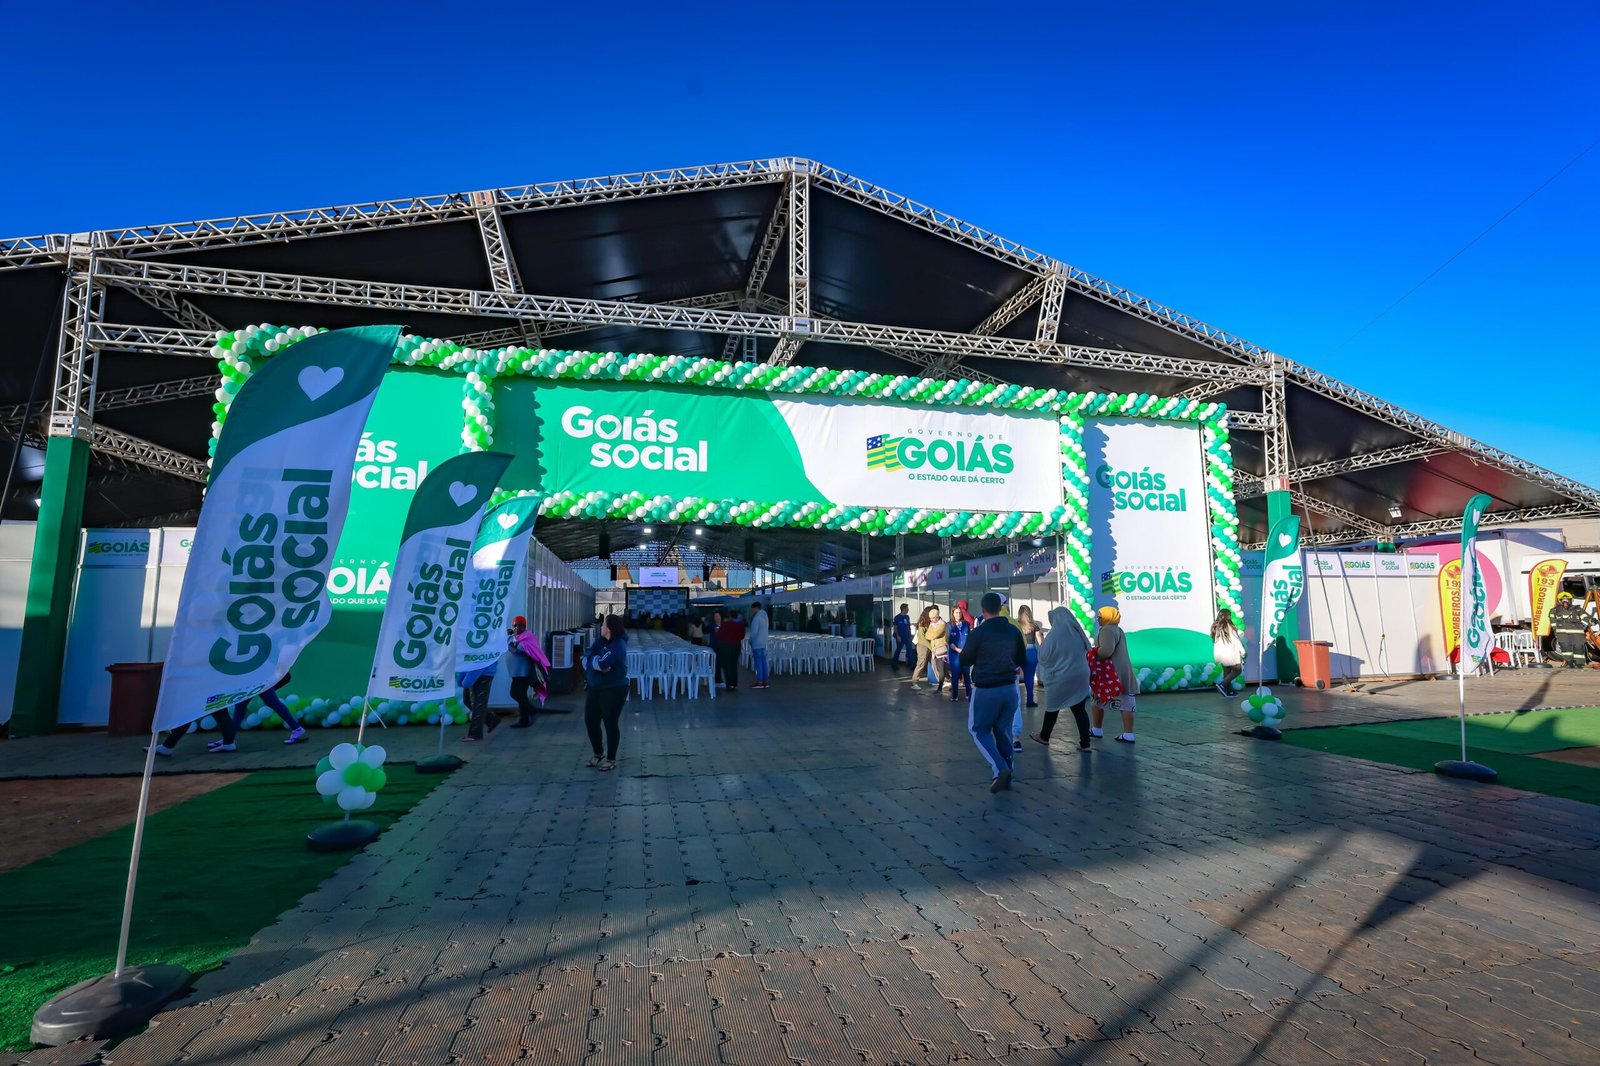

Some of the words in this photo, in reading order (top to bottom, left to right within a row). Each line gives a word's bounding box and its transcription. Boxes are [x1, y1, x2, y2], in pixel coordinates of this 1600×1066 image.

[561, 405, 679, 444] Goiás
[907, 428, 973, 438] GOVERNO
[589, 440, 708, 472] social
[896, 434, 1014, 474] GOIÁS
[917, 474, 948, 482] ESTADO
[949, 475, 966, 483] QUE
[968, 474, 979, 483] DÁ
[980, 476, 1005, 485] CERTO
[1095, 464, 1166, 491] Goiás
[1115, 488, 1187, 512] social
[100, 539, 149, 553] GOIÁS
[281, 468, 334, 629] social
[1350, 560, 1371, 569] GOIÁS
[1415, 561, 1435, 569] GOIÁS
[433, 537, 472, 647] social
[1119, 567, 1193, 593] GOIÁS
[1537, 577, 1555, 586] 193
[208, 512, 278, 676] Goiás
[367, 597, 379, 605] DÁ
[492, 560, 516, 630] social
[393, 561, 444, 669] Goiás
[466, 578, 496, 649] Goiás
[471, 652, 500, 662] GOIÁS
[400, 676, 445, 690] GOIÁS
